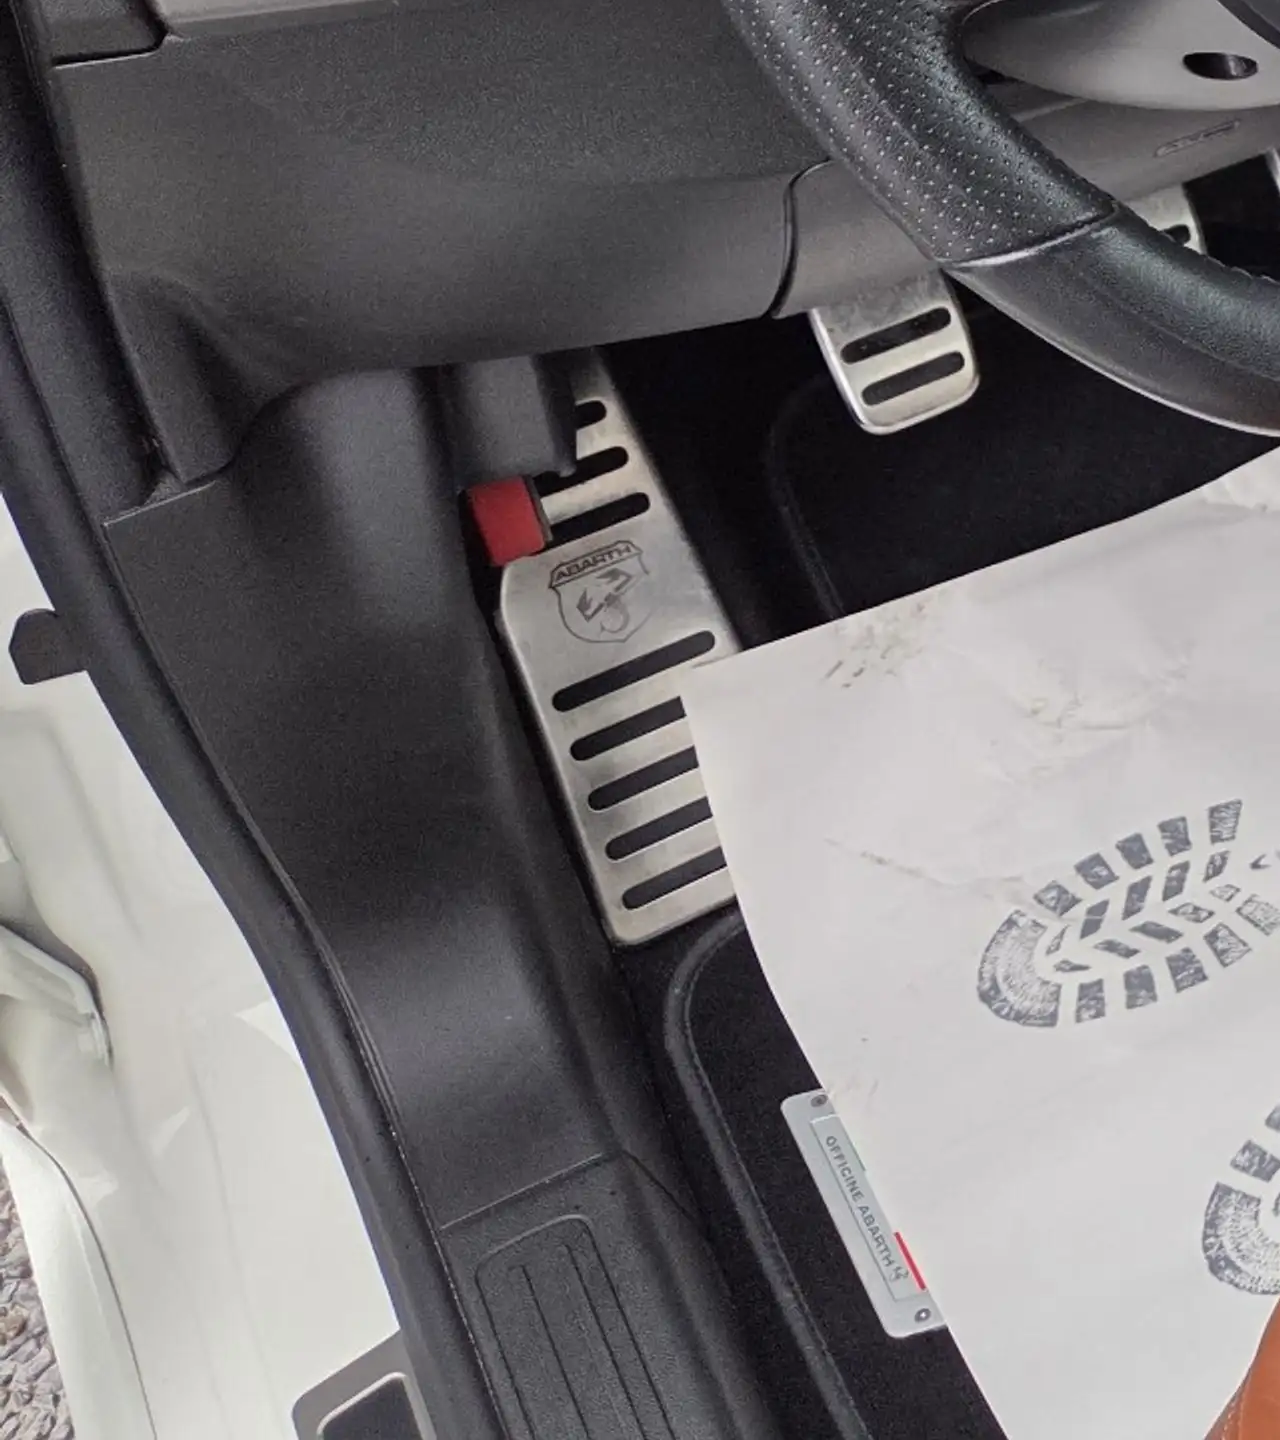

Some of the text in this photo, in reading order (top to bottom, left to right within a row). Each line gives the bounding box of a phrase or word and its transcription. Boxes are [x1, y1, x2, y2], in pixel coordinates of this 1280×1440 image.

[555, 544, 632, 581] ABARTH
[825, 1135, 896, 1267] OFFICINE ABARTH
